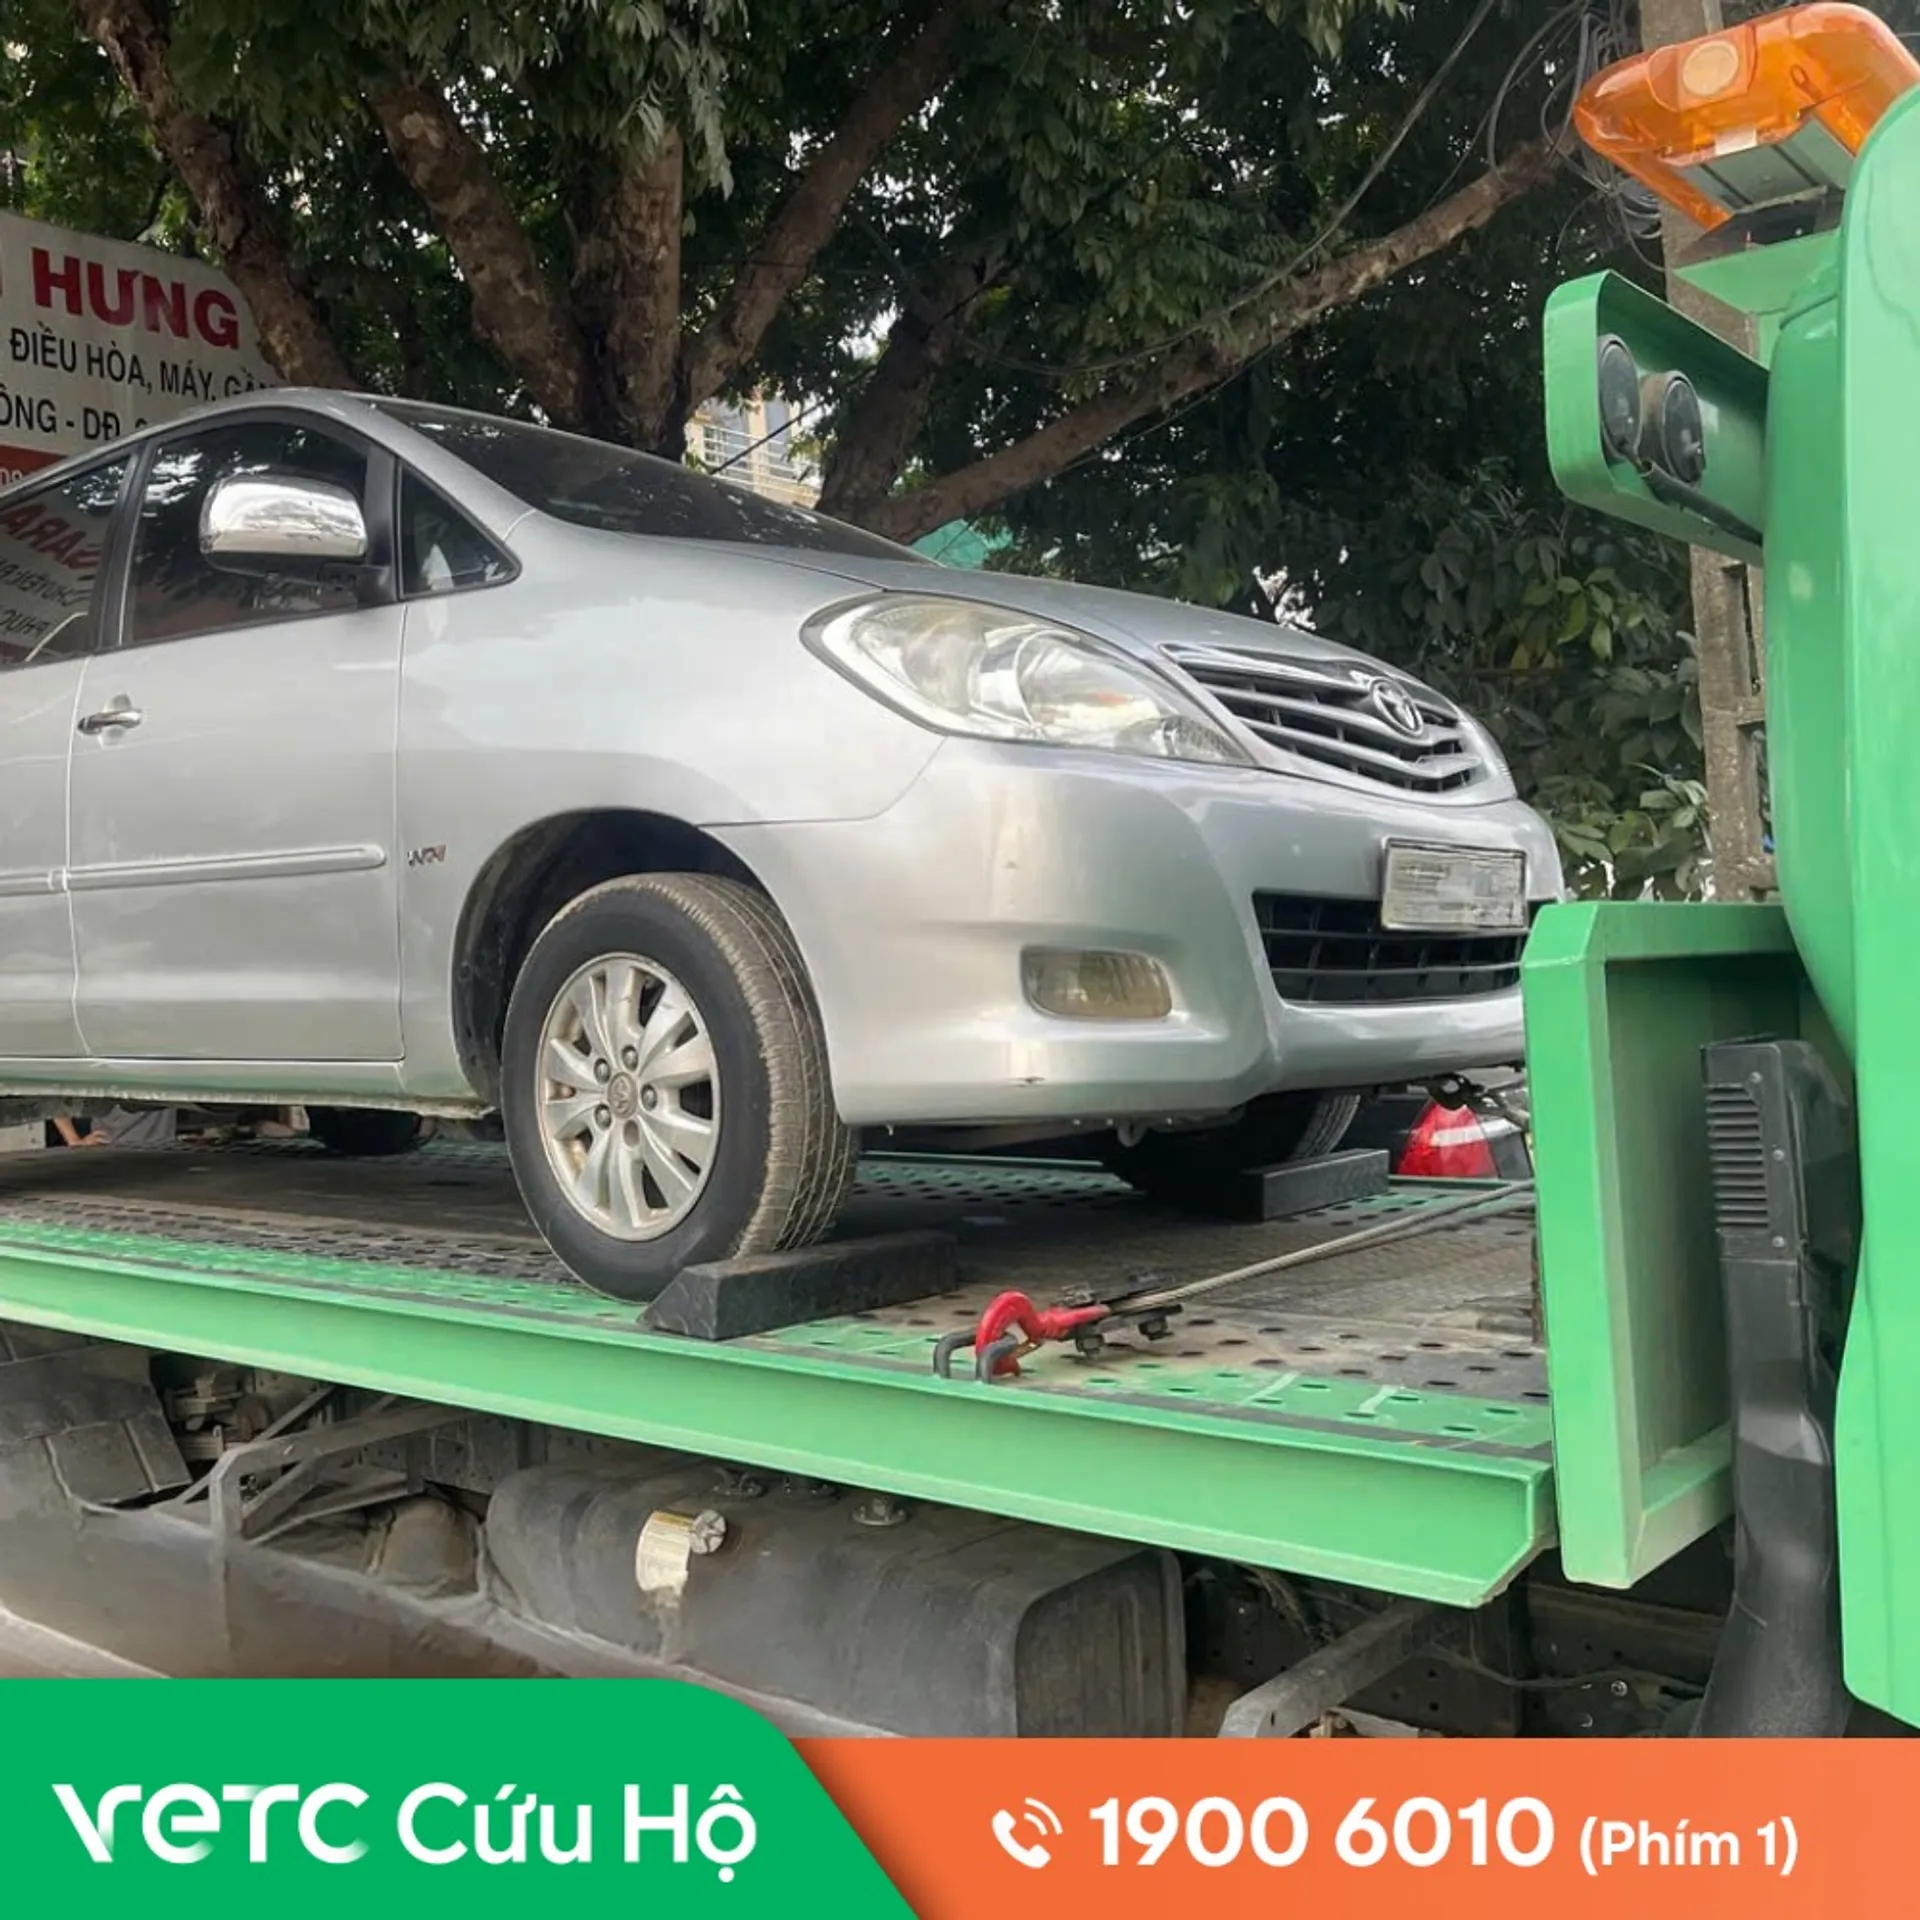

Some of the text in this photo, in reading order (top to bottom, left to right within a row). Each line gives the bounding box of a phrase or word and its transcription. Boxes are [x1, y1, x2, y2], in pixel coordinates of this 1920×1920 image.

[31, 247, 239, 349] HƯNG
[10, 320, 77, 373] ĐIỀU
[86, 340, 153, 395] HÒA,
